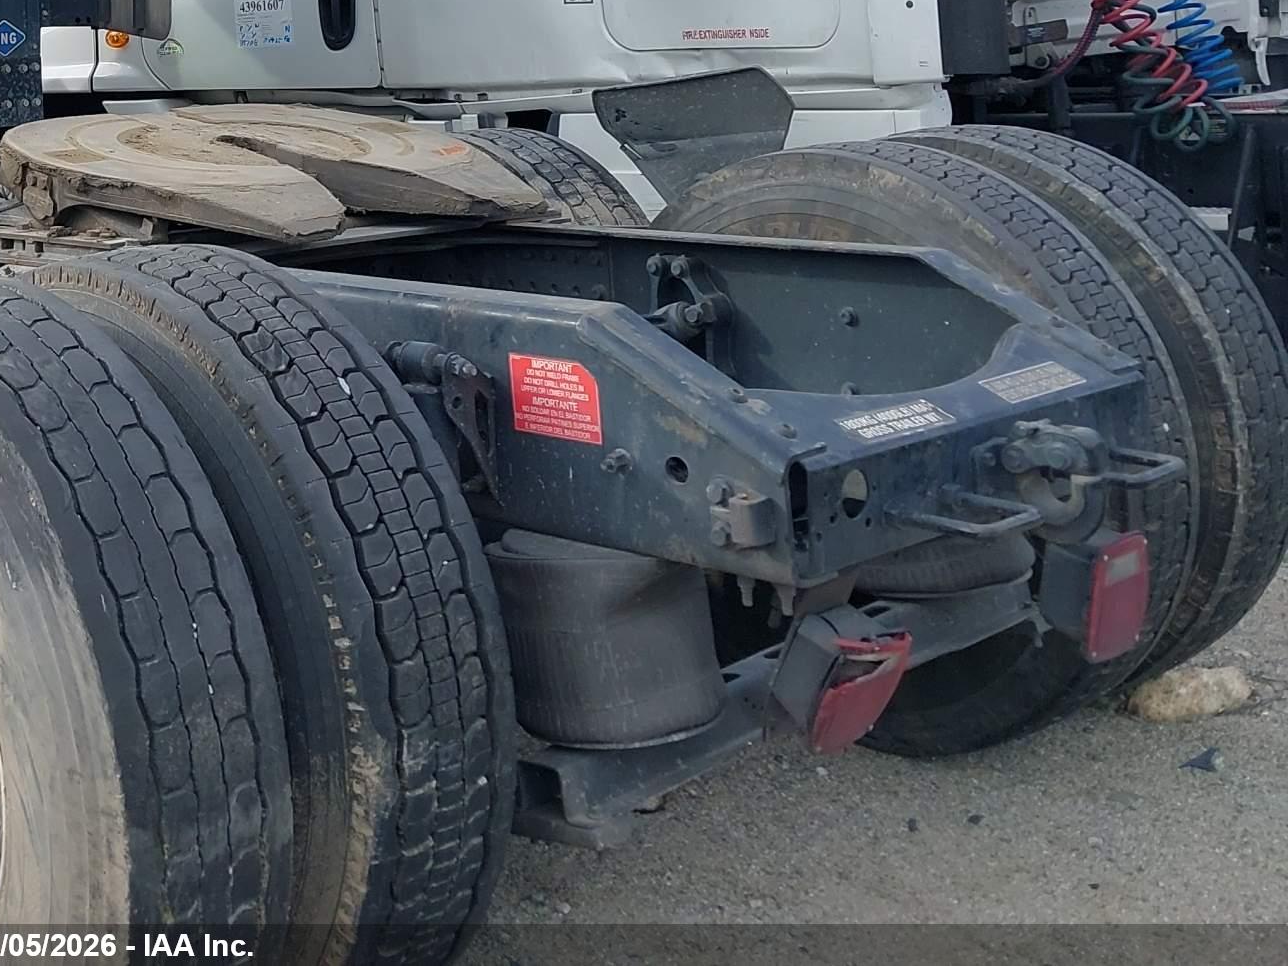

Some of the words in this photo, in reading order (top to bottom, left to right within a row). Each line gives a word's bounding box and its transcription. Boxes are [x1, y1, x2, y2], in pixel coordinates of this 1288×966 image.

[699, 29, 746, 40] EXTINGUISHER
[531, 359, 572, 373] IMPORTANT
[544, 380, 559, 388] DRILL
[560, 382, 577, 391] HOLES
[533, 396, 578, 411] IMPORTANTE
